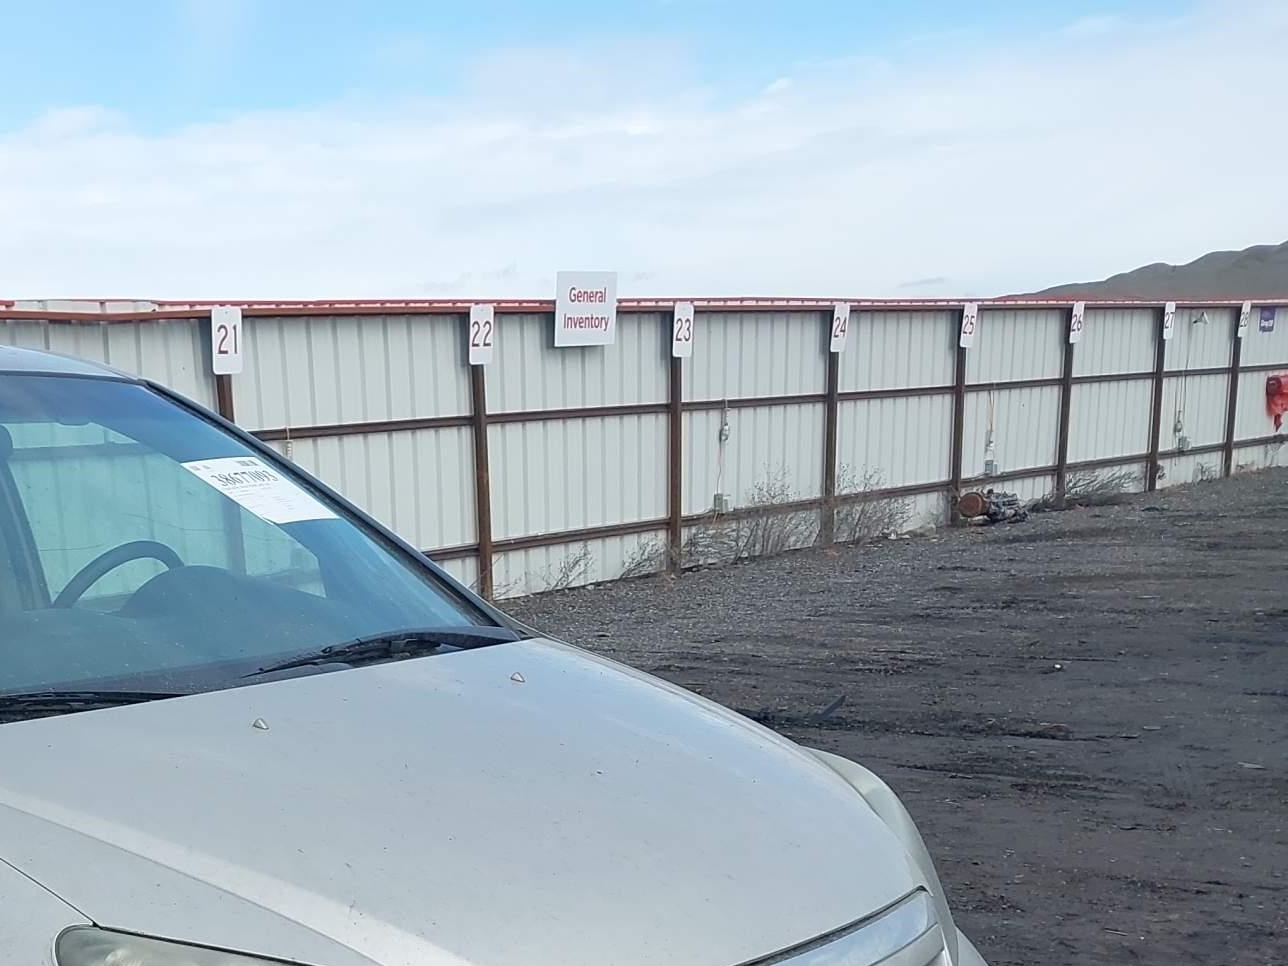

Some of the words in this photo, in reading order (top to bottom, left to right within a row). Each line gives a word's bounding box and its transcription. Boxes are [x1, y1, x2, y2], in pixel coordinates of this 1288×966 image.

[568, 286, 607, 304] General
[563, 313, 610, 332] Inventory
[675, 318, 692, 342] 23
[833, 316, 848, 338] 24
[962, 314, 975, 335] 25
[1071, 314, 1083, 332] 26
[1164, 311, 1175, 329] 27
[217, 324, 238, 355] 21
[471, 320, 492, 347] 22
